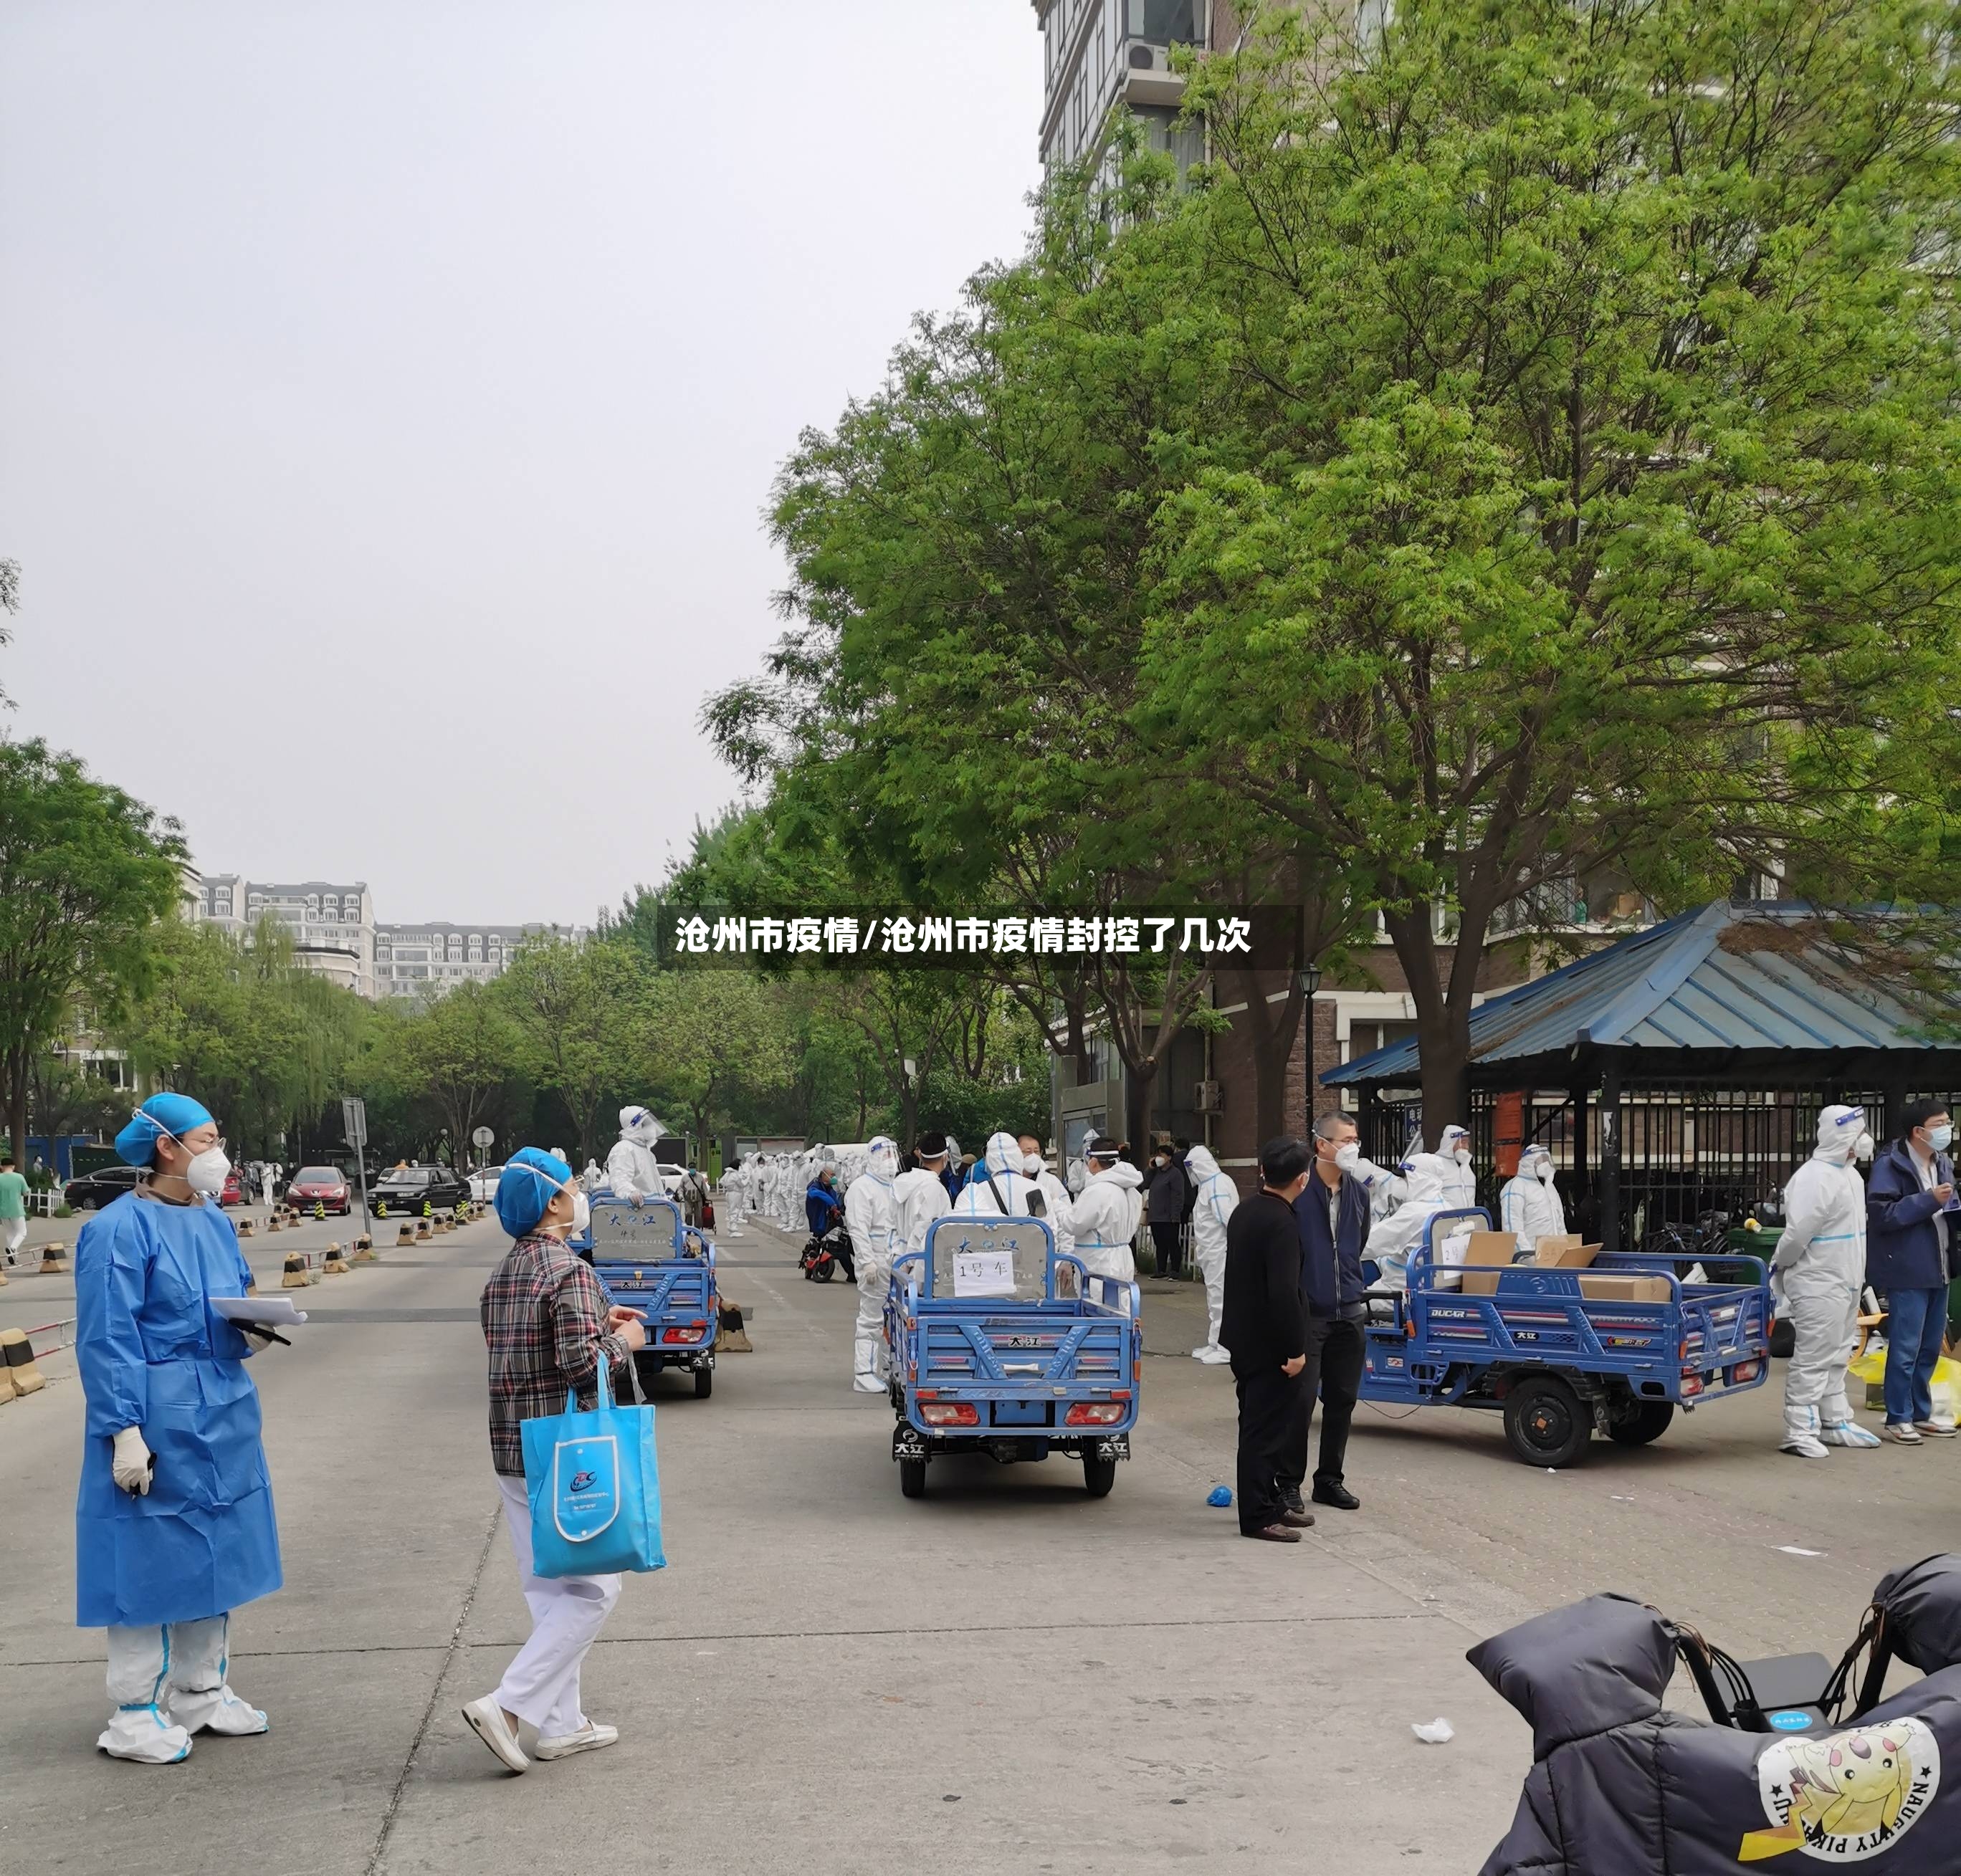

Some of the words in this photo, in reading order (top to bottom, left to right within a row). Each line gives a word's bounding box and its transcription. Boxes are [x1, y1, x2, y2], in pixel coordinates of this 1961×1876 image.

[621, 1281, 645, 1289] 大江
[1431, 1309, 1466, 1319] DUCAR
[1517, 1331, 1537, 1340] 大江
[1008, 1336, 1041, 1347] 大江
[894, 1442, 925, 1454] 大江
[1099, 1442, 1128, 1453] 大江
